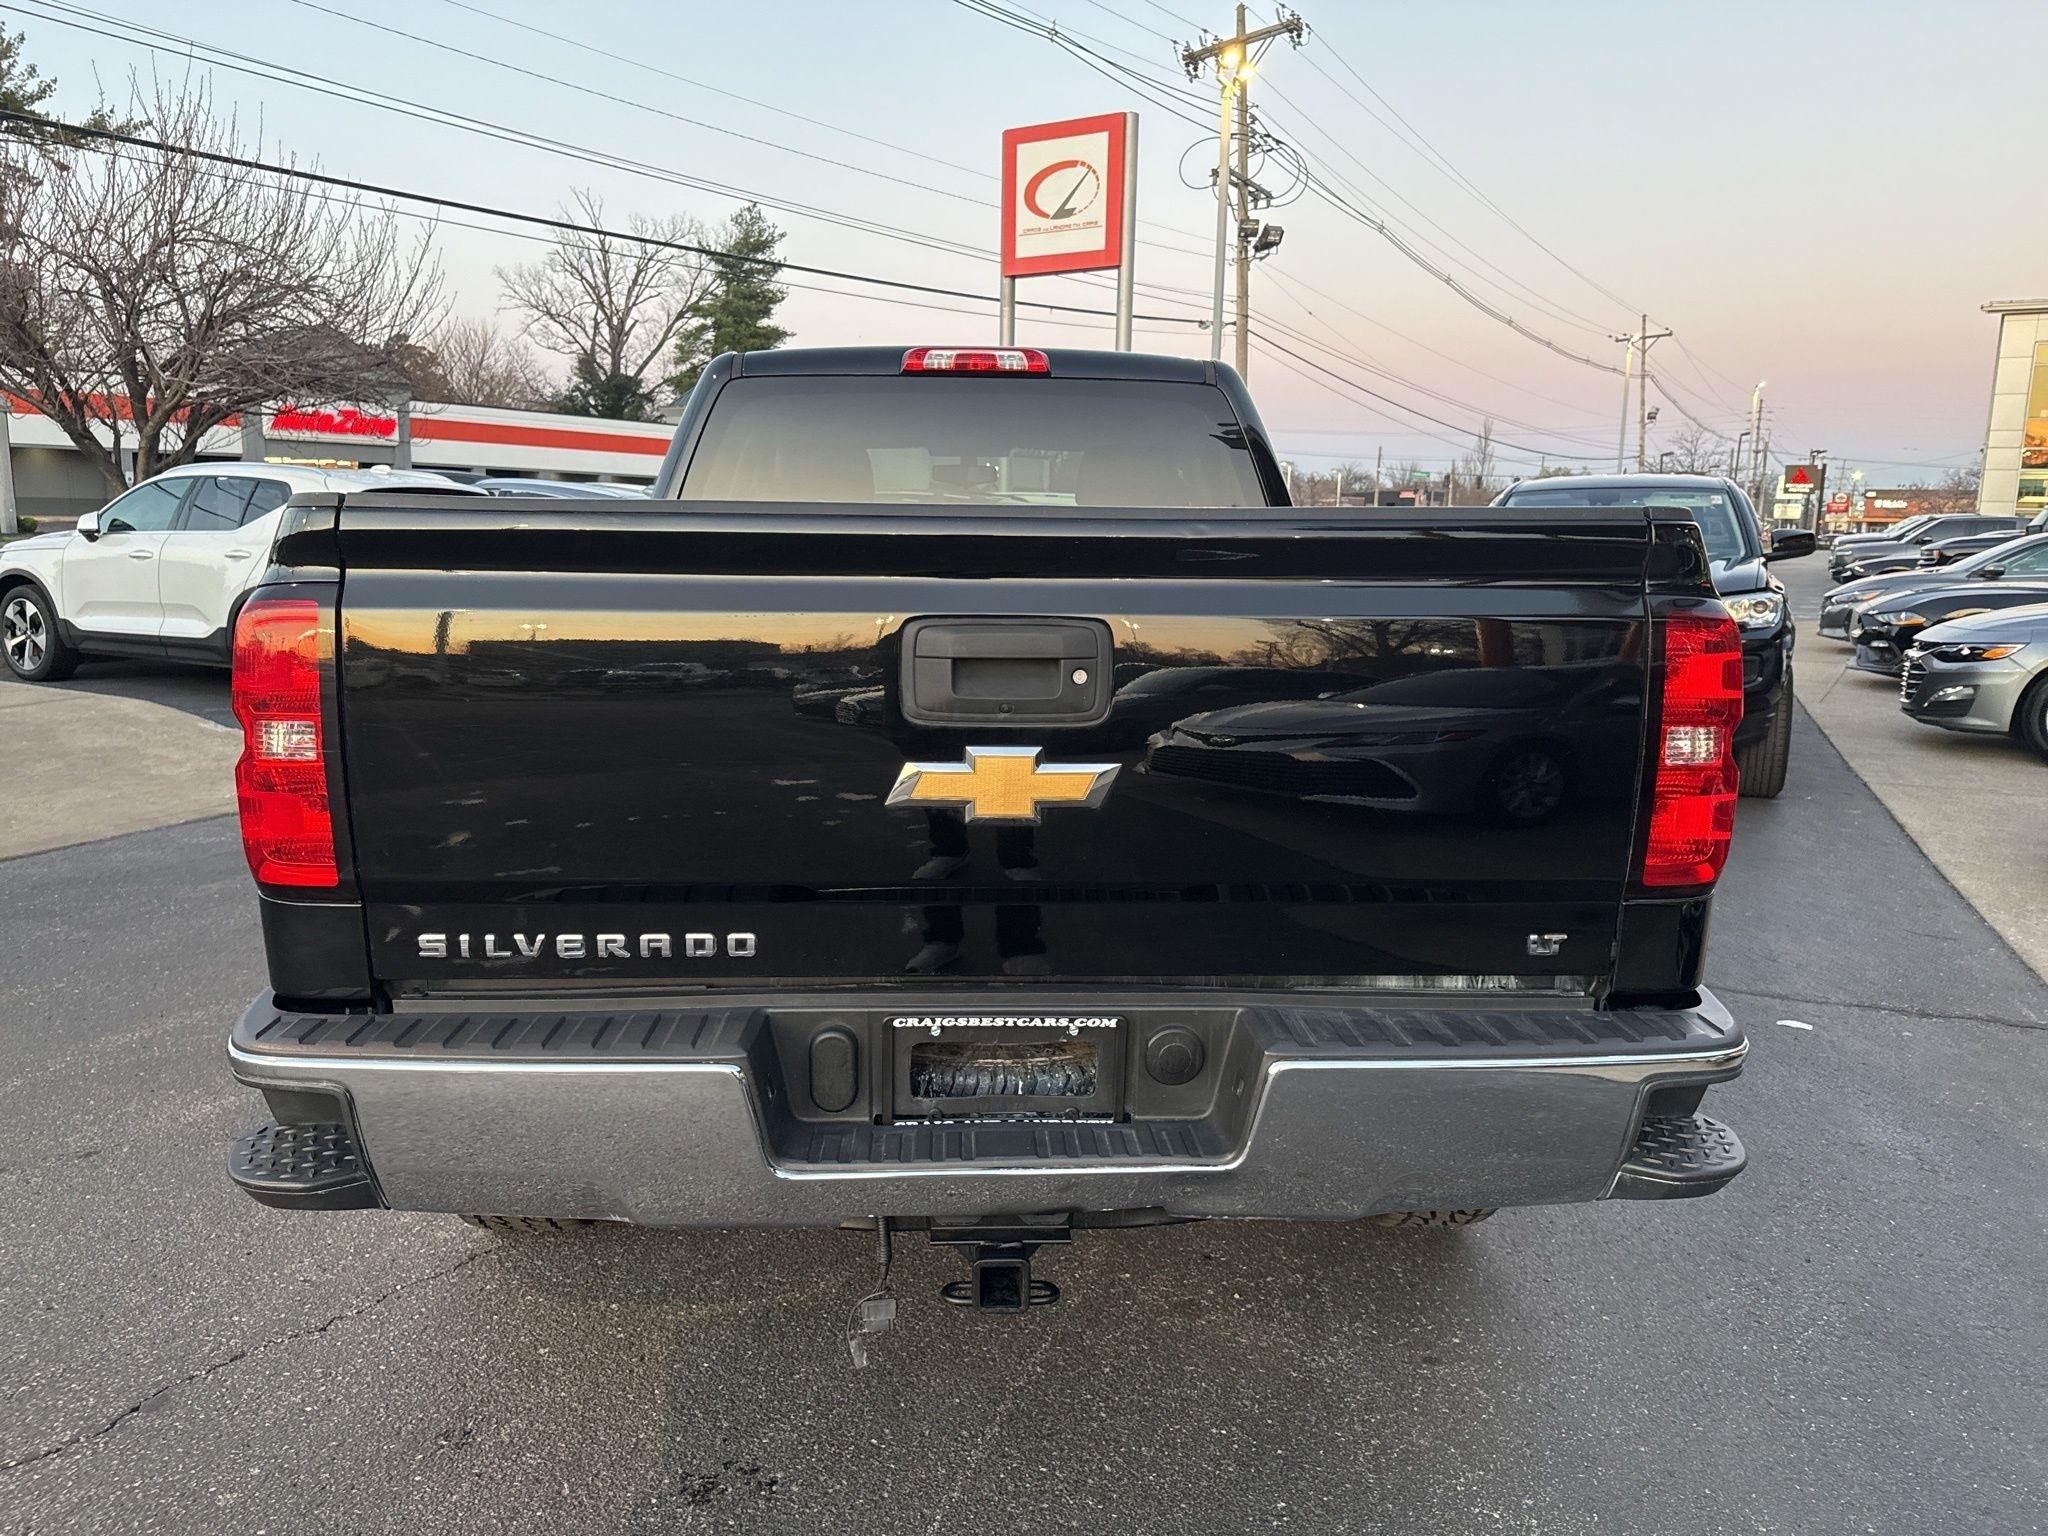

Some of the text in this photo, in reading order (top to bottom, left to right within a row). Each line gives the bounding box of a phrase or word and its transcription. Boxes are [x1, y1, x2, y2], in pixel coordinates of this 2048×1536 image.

[272, 404, 397, 437] AutoZone
[417, 932, 757, 958] SILVERADO
[1527, 934, 1568, 956] LT
[892, 1017, 1118, 1028] CRAIGSBESTCARS.COM
